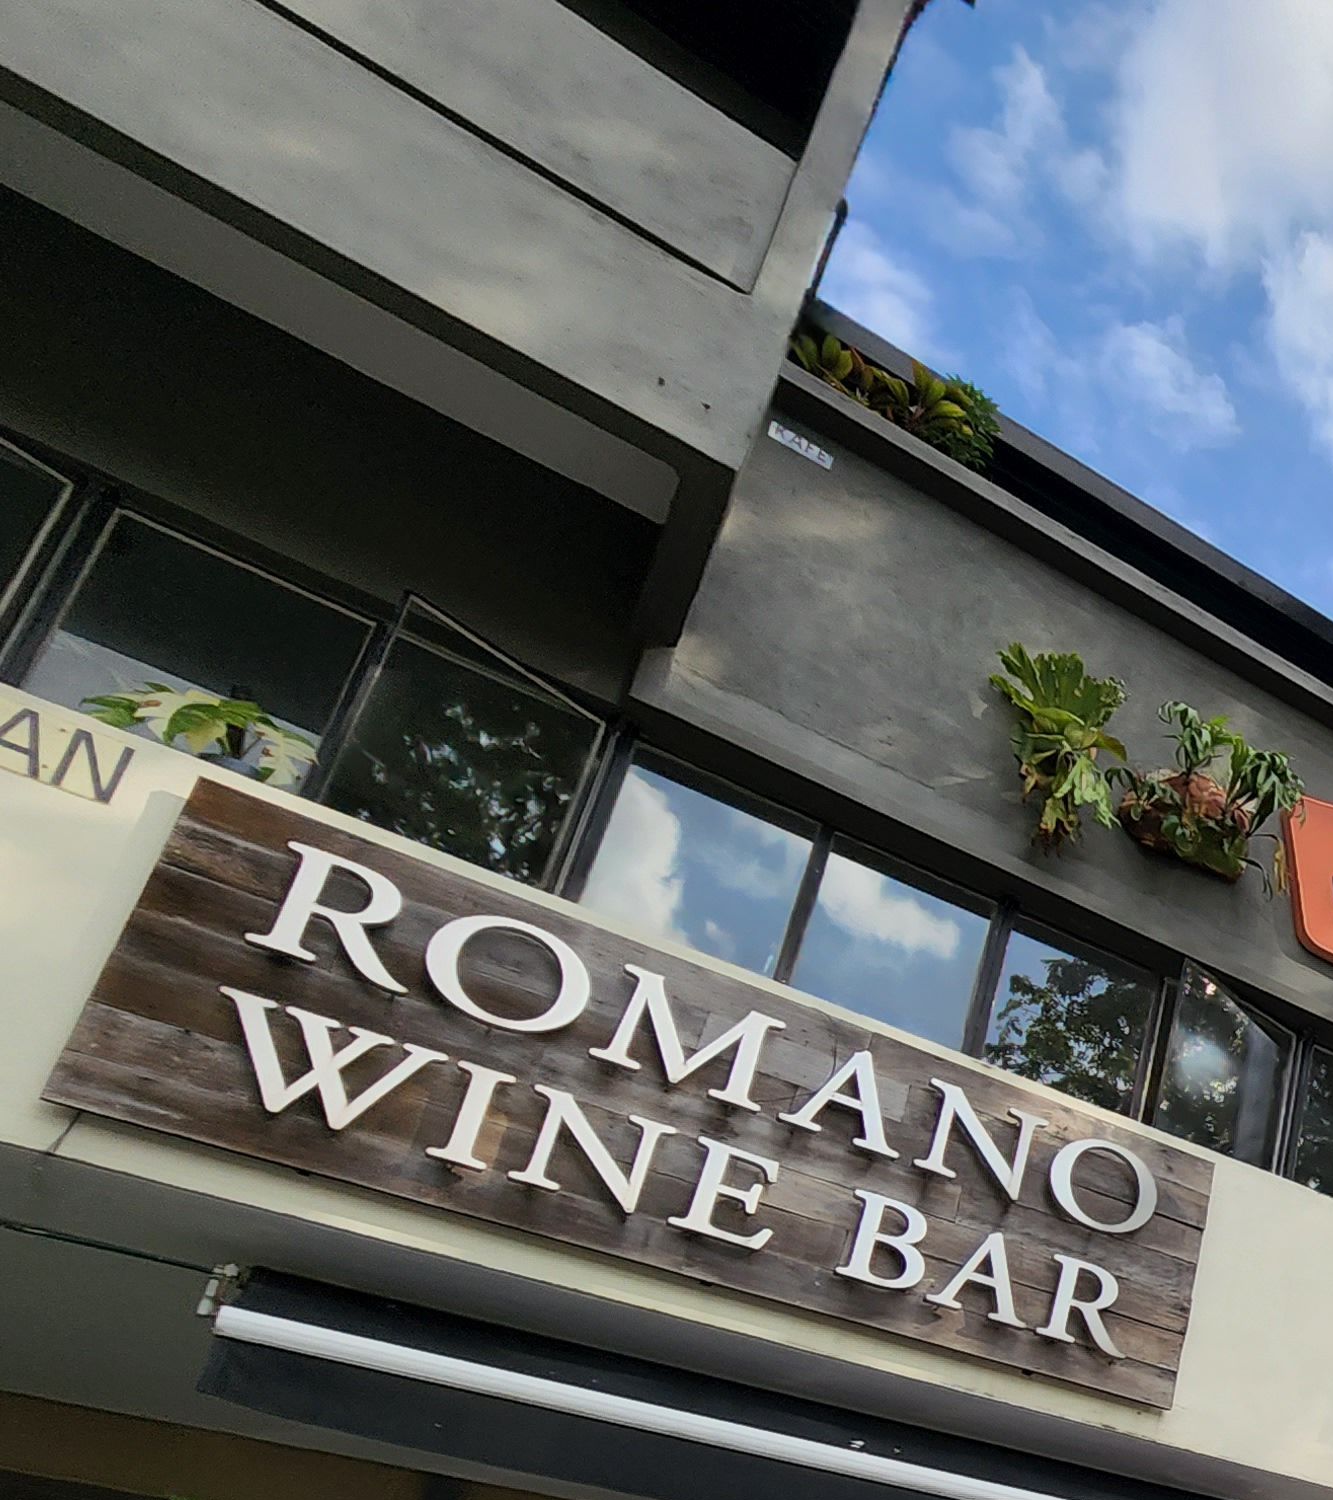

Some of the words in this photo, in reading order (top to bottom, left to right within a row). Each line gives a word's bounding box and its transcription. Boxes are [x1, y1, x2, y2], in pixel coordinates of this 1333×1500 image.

[219, 985, 780, 1250] WINE
[835, 1188, 1126, 1359] BAR
[245, 840, 1159, 1234] ROMANO
